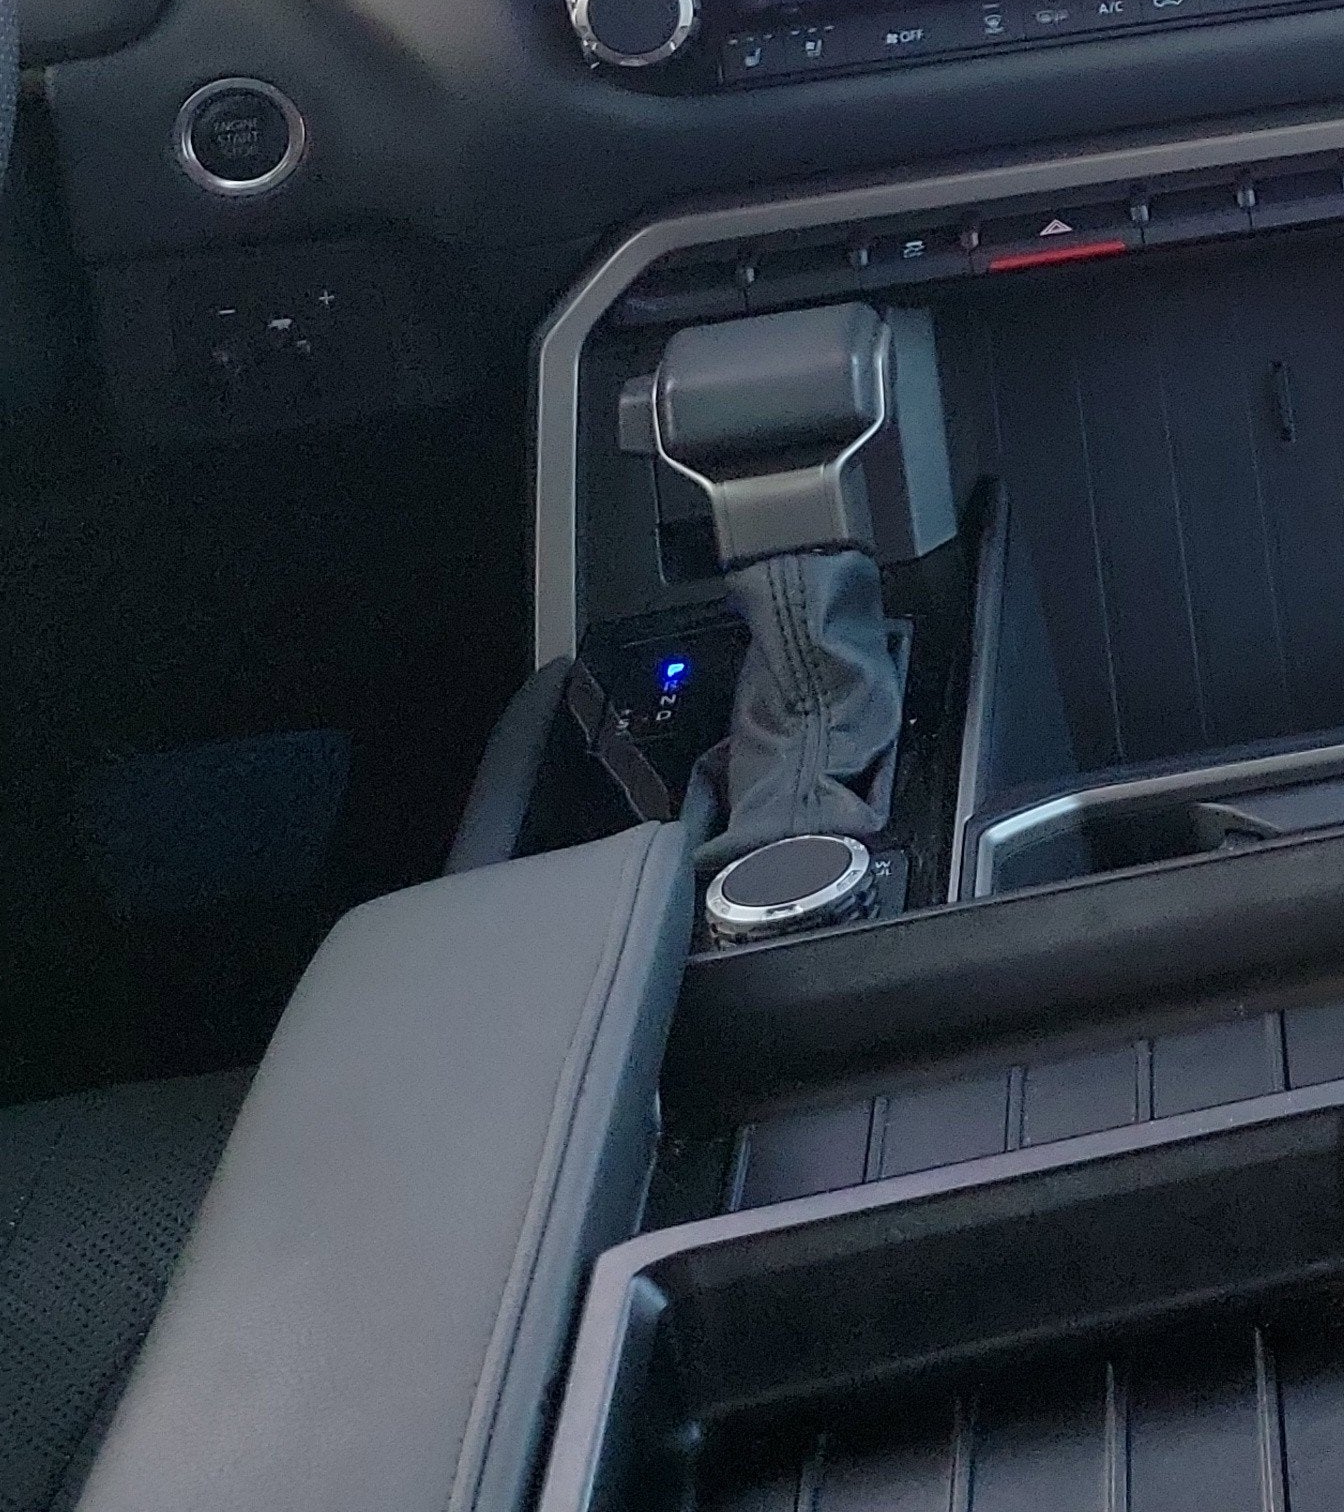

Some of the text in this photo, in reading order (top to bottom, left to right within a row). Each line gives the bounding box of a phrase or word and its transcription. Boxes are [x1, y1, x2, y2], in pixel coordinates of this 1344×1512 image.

[1099, 0, 1124, 14] A/C
[900, 28, 924, 42] OFF
[667, 663, 685, 677] P
[660, 694, 677, 706] N
[655, 710, 672, 721] D
